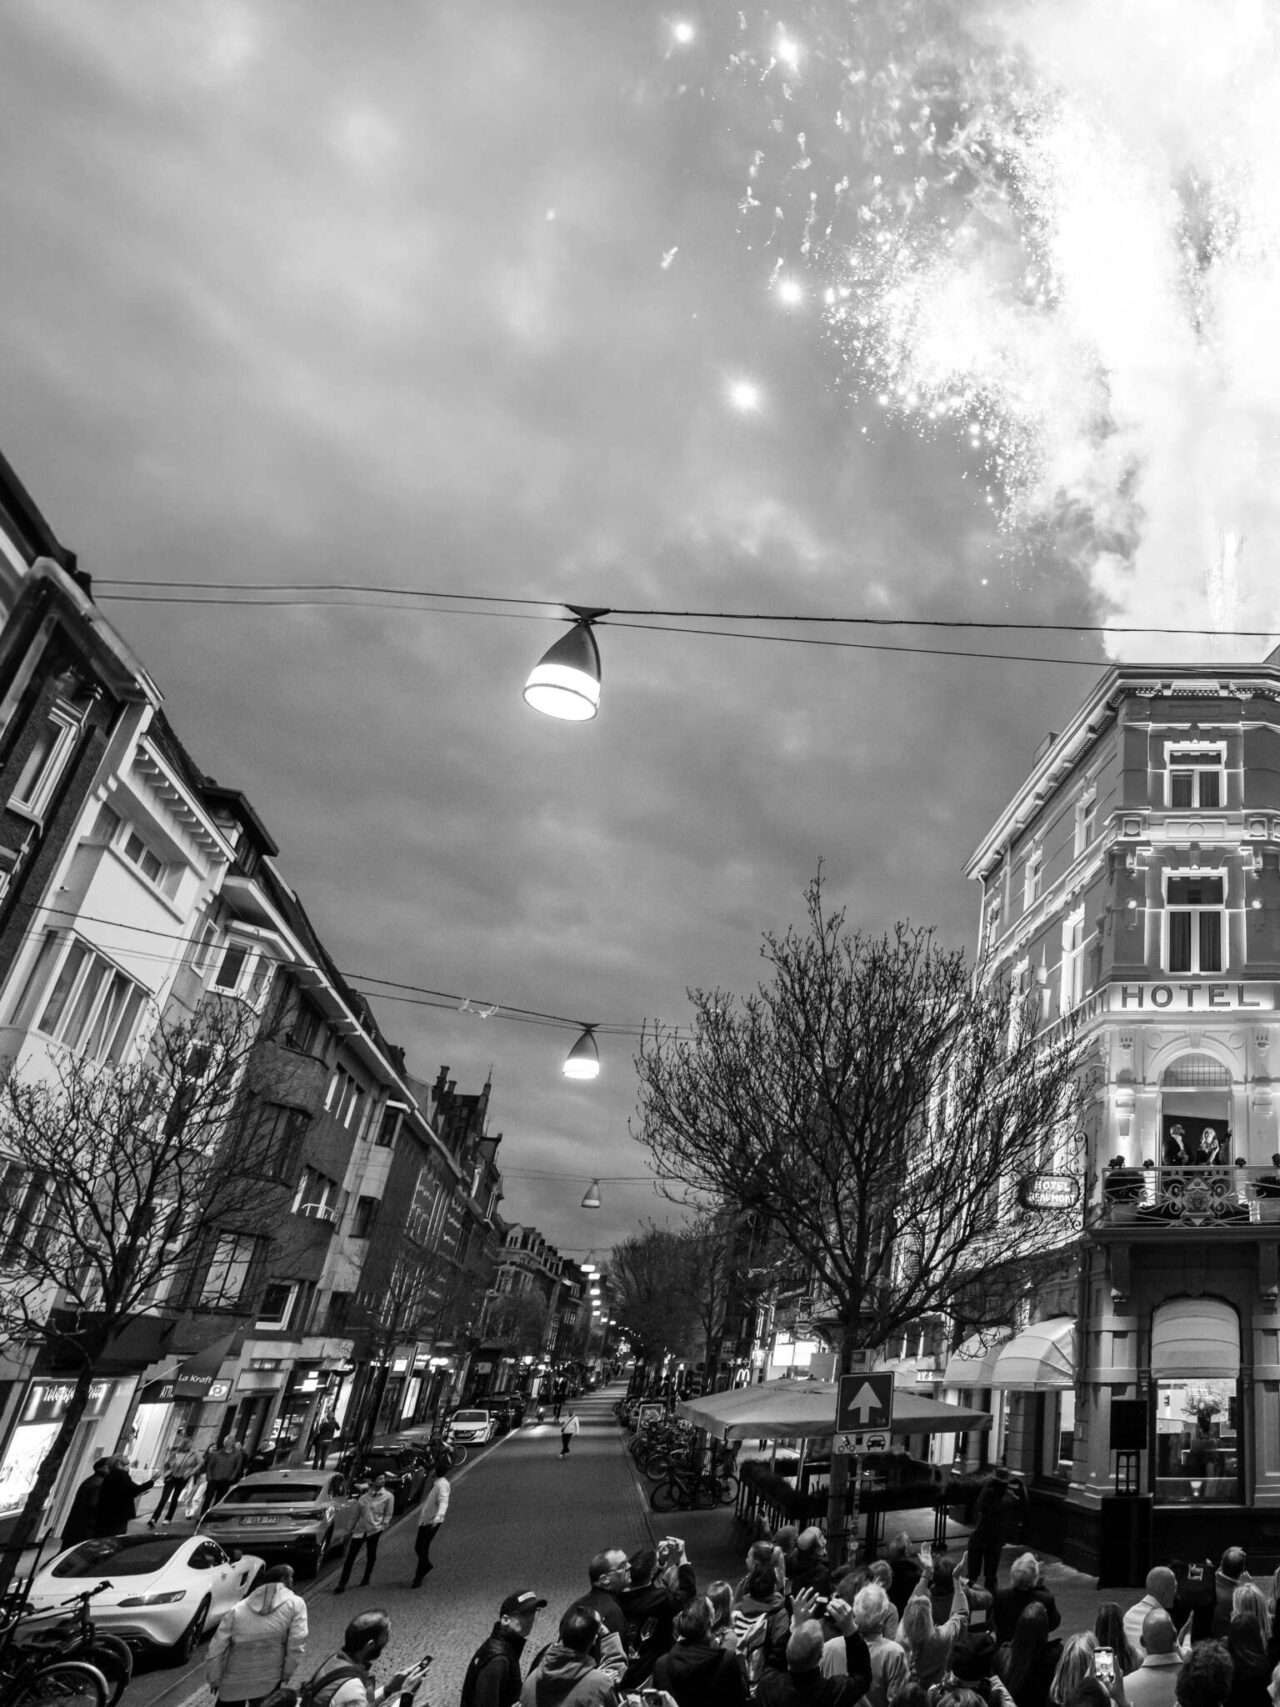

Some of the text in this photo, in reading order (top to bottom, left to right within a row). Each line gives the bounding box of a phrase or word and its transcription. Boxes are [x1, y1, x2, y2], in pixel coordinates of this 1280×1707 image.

[1121, 983, 1260, 1008] HOTEL
[1035, 1181, 1071, 1192] HOTEL
[178, 1373, 212, 1384] La Kraft
